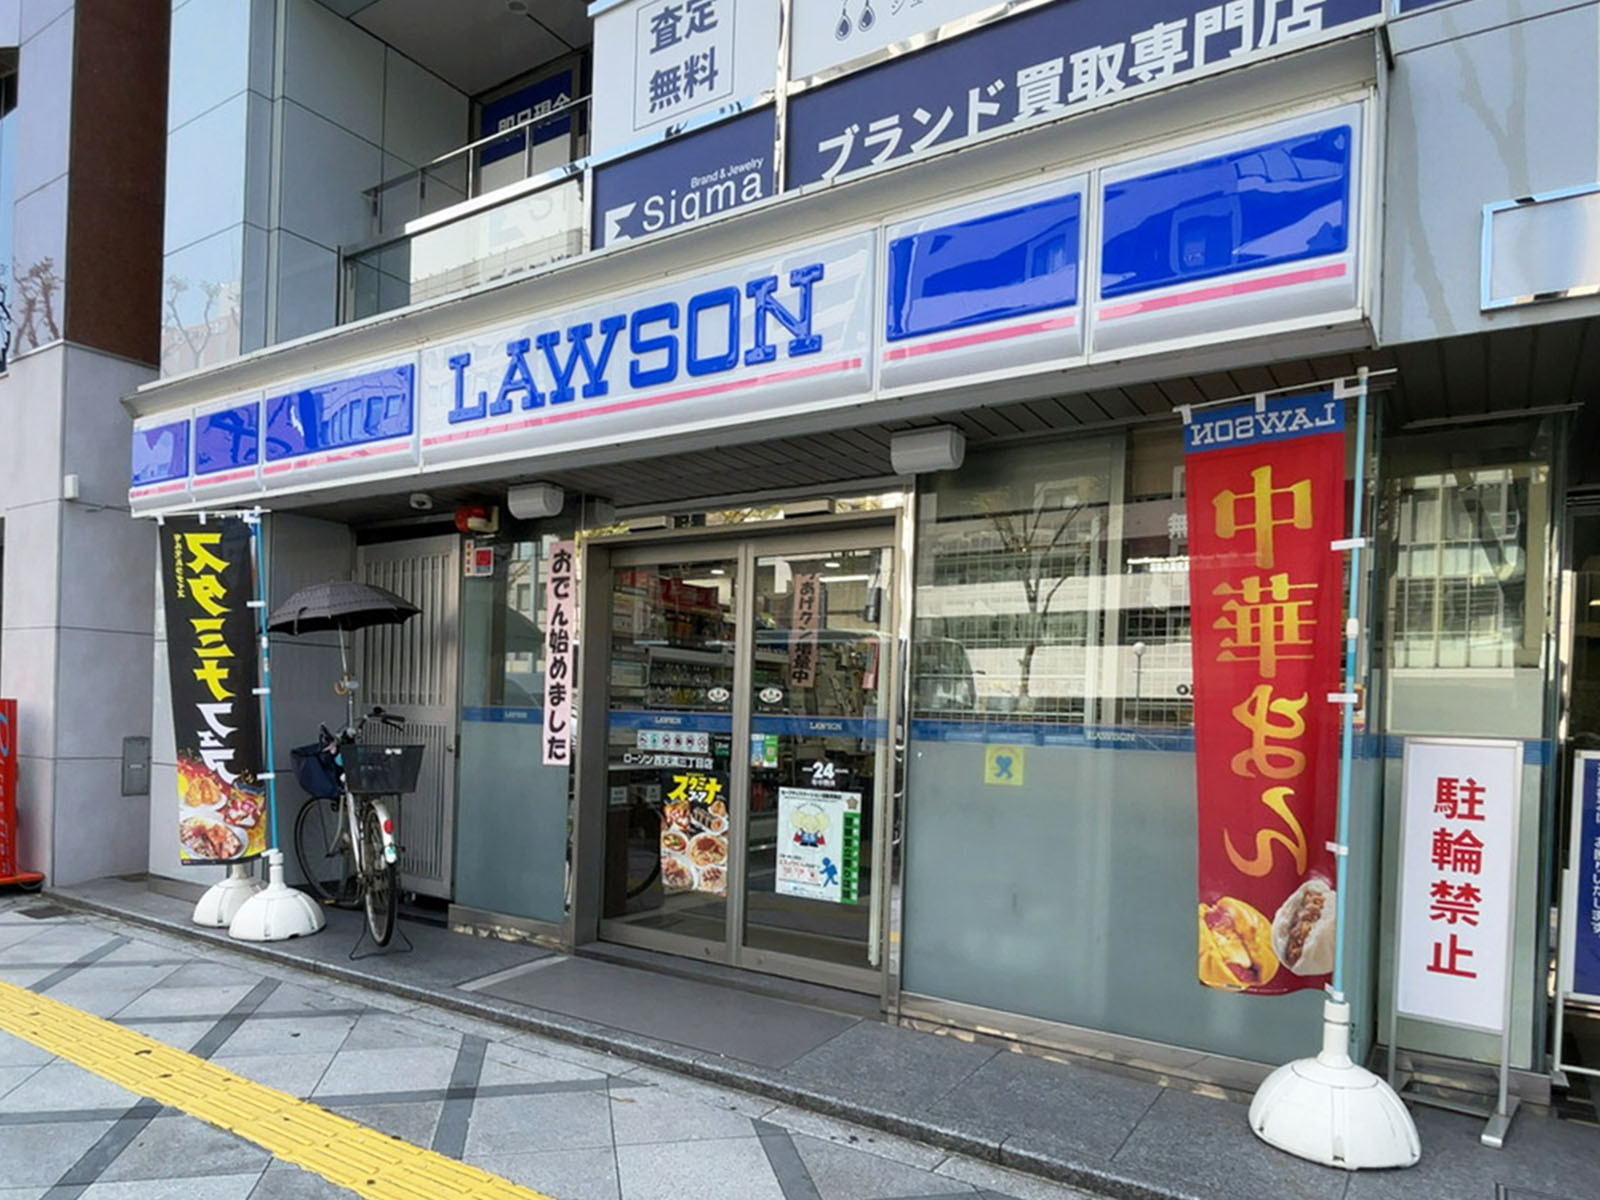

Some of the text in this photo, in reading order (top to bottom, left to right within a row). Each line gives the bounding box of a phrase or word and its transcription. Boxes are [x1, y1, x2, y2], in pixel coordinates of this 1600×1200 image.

[650, 0, 718, 54] 査定
[649, 46, 718, 113] 無料
[818, 0, 1326, 180] ブランド買取専門店
[642, 172, 763, 231] Sigma
[690, 157, 764, 189] Brand & Jewelry
[447, 262, 825, 425] LAWSON
[547, 548, 572, 761] おでん始めました
[812, 761, 835, 780] 24
[1426, 776, 1487, 979] 駐輪禁止
